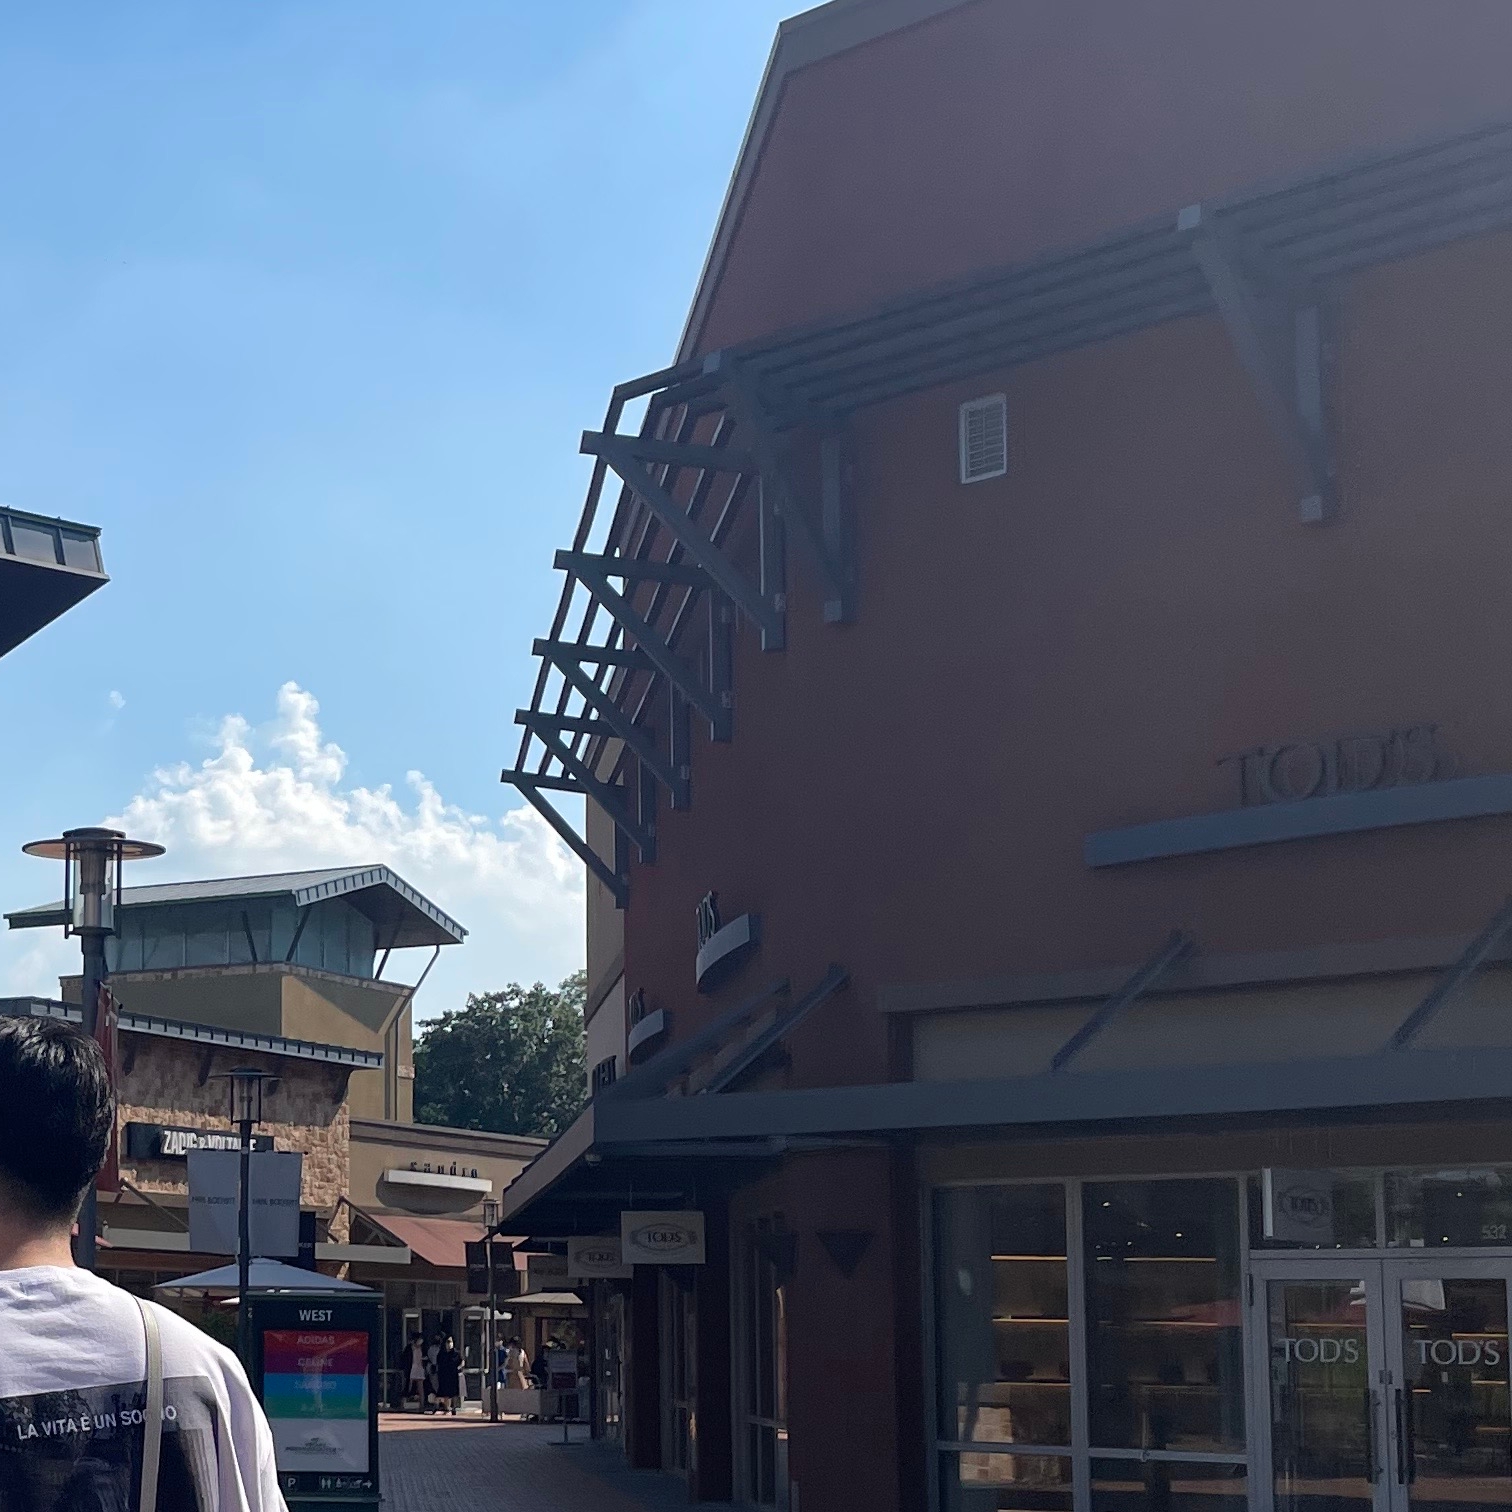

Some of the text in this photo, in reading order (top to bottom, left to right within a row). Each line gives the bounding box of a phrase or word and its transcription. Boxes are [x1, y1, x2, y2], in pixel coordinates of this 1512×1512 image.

[207, 1135, 257, 1151] VOLTAIE
[299, 1309, 333, 1322] WEST
[296, 1335, 336, 1346] ADIDAS
[1278, 1338, 1359, 1364] TOD'S
[1414, 1340, 1501, 1366] TOD'S
[17, 1405, 178, 1440] LA VITA È UN SOO
